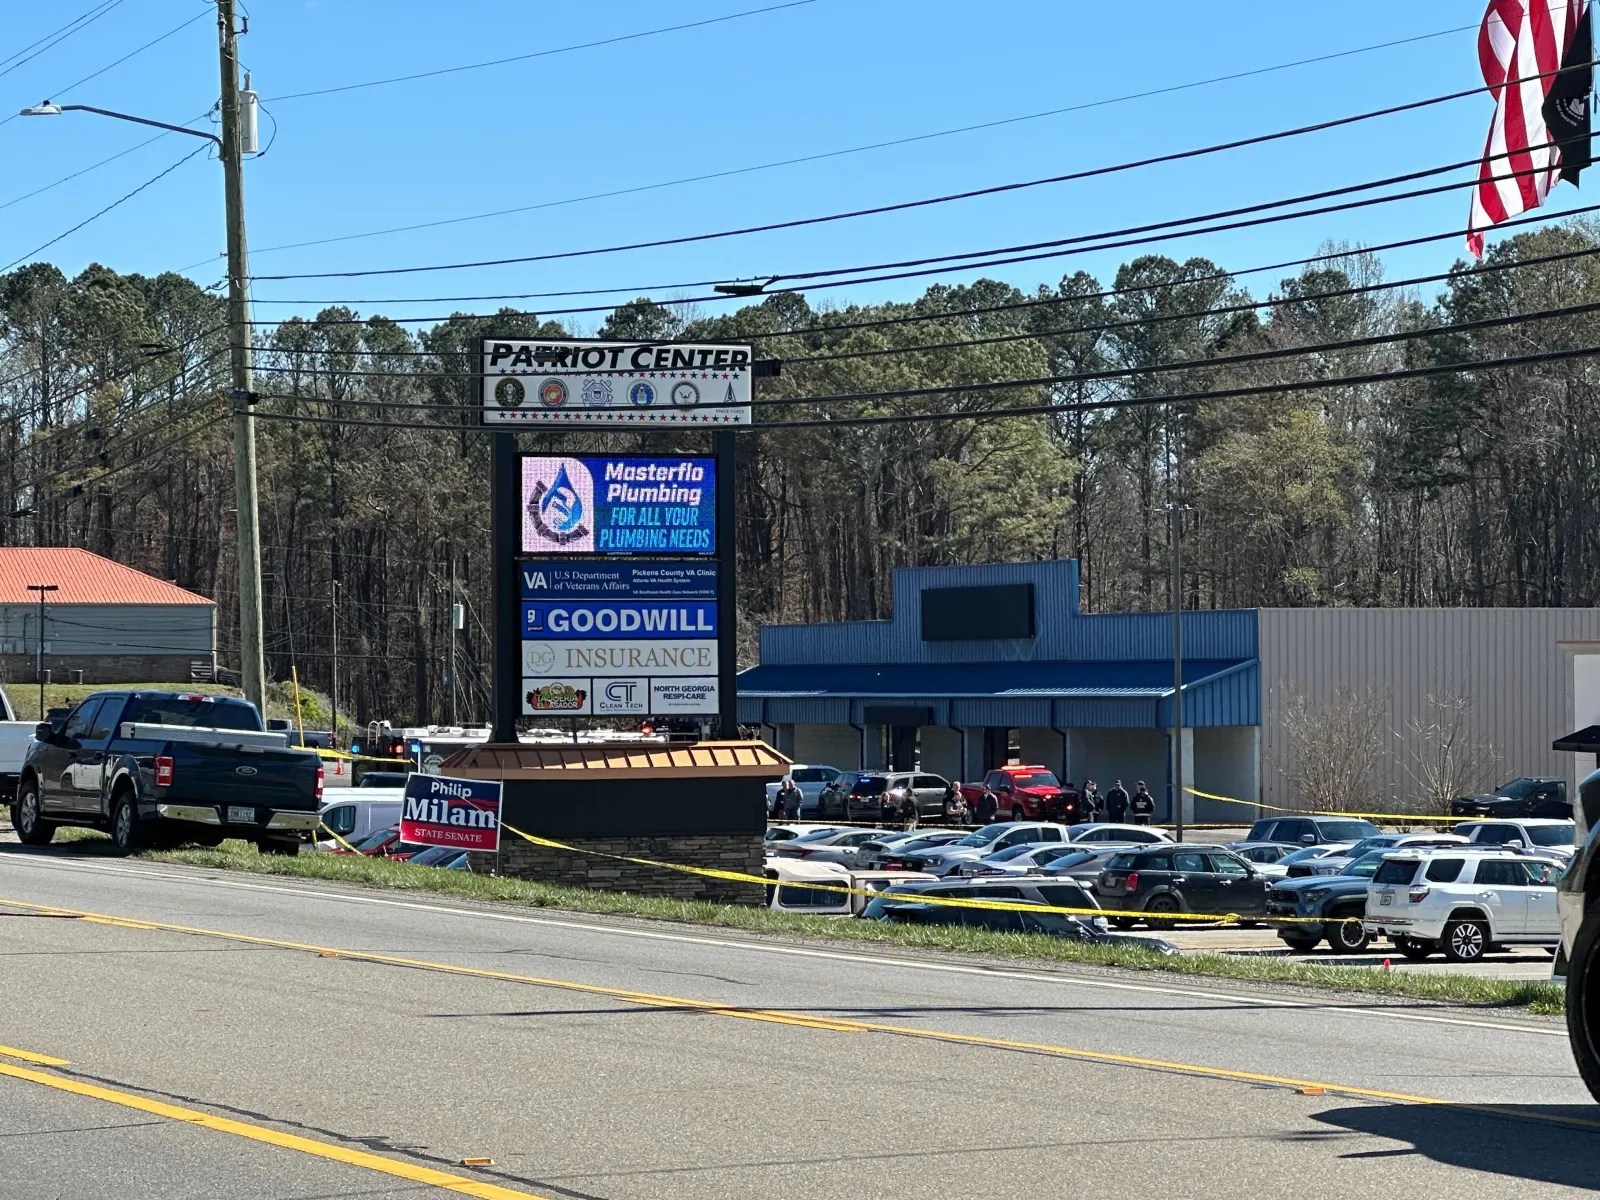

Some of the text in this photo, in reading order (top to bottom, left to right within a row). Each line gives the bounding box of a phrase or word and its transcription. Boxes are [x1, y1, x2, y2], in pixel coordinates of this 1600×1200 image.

[630, 347, 748, 371] CENTER
[605, 462, 704, 481] Masterflo
[607, 483, 702, 506] Plumbing
[611, 507, 699, 525] FOR ALL YOUR
[600, 528, 710, 548] PLUMBING NEEDS
[523, 571, 548, 589] VA
[572, 571, 620, 581] Department
[660, 569, 684, 577] County
[554, 582, 630, 590] of Veterans Affairs
[547, 608, 714, 632] GOODWILL
[565, 648, 712, 668] INSURANCE
[549, 701, 578, 709] ASADOR
[430, 781, 472, 799] Philip
[404, 797, 496, 829] Milam
[414, 827, 482, 843] STATE SENATE
